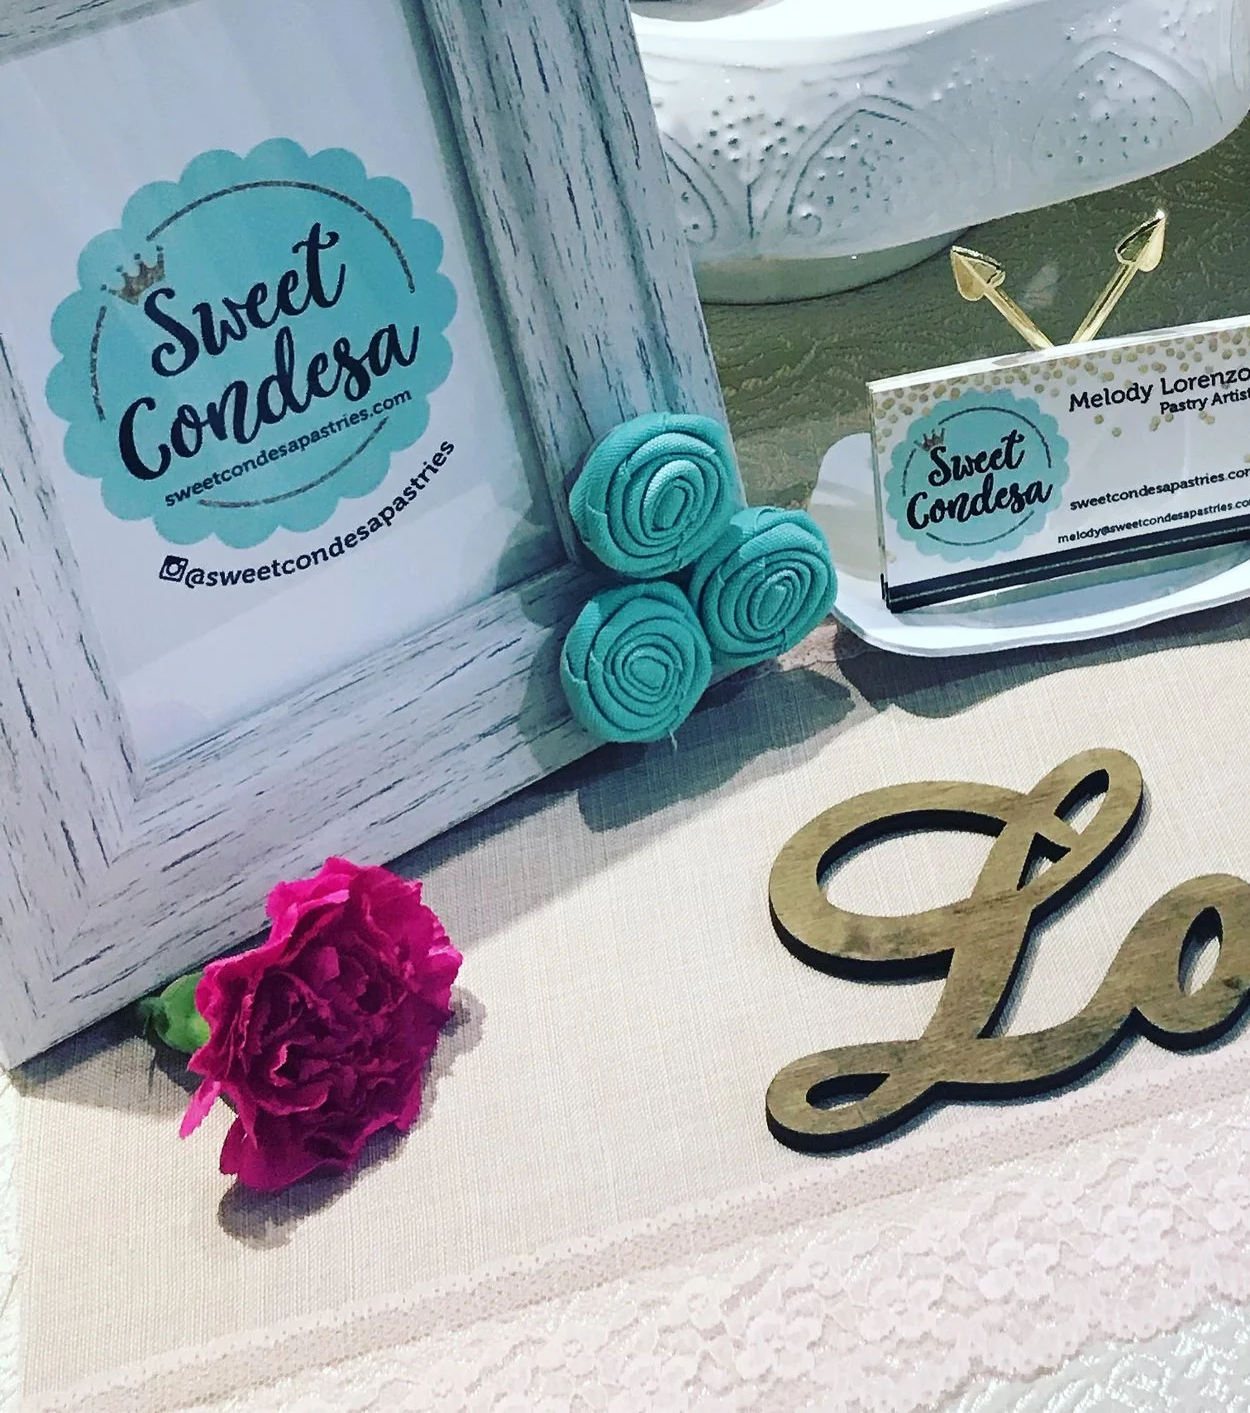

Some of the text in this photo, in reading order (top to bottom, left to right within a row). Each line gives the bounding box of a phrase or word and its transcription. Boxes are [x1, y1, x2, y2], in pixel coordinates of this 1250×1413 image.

[143, 222, 347, 378] Sweet
[118, 322, 420, 481] Condesa
[1068, 382, 1154, 413] Melody
[1159, 396, 1208, 417] Pastry
[164, 388, 413, 508] sweetcondesapastries.com
[927, 428, 1026, 488] Sweet
[185, 439, 456, 589] @sweetcondesapastries
[906, 472, 1054, 532] Condesa
